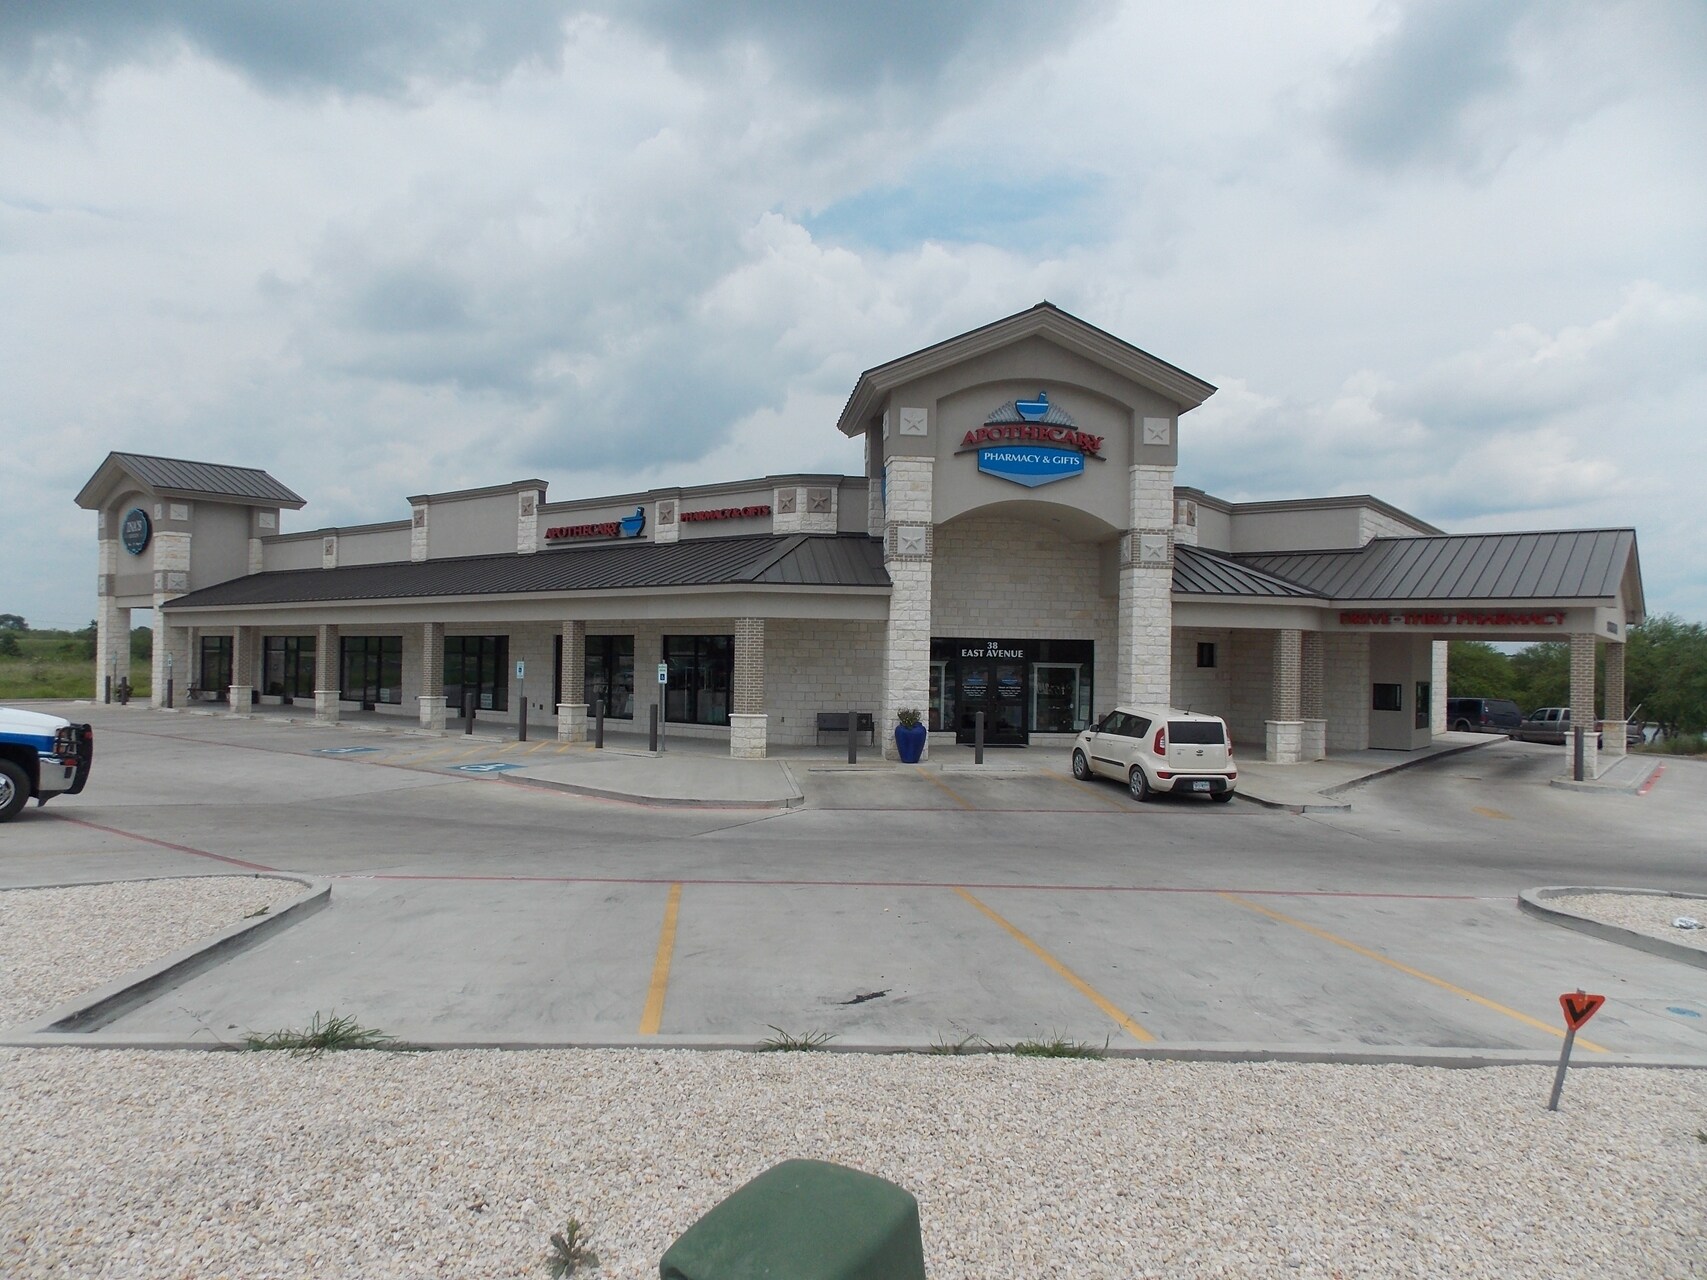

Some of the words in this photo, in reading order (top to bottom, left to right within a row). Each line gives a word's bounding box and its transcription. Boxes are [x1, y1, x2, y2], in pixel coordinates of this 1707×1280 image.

[960, 425, 1104, 453] APOTHECARY
[984, 452, 1040, 463] PHARMACY
[1042, 455, 1050, 464] &
[1052, 455, 1080, 466] GIFTS
[680, 510, 730, 522] PHARMACY
[741, 505, 771, 518] GIFTS
[544, 522, 620, 539] APOTHECARY
[1456, 612, 1567, 625] PHARMACY
[987, 641, 998, 650] 38
[961, 649, 984, 657] EAST
[986, 649, 1024, 658] AVENUE
